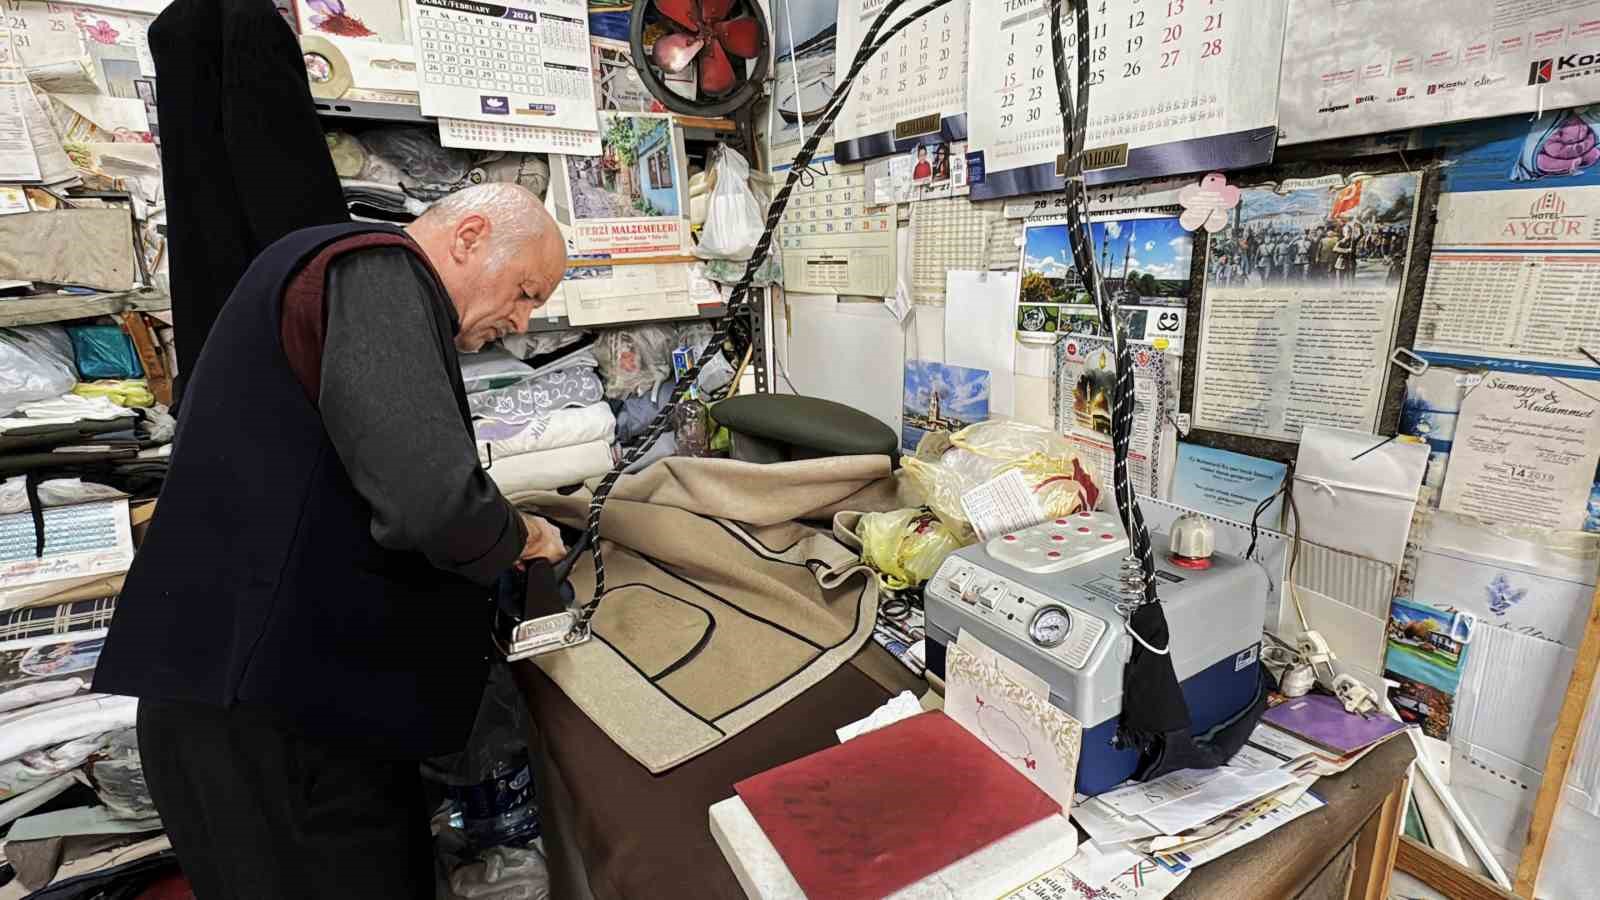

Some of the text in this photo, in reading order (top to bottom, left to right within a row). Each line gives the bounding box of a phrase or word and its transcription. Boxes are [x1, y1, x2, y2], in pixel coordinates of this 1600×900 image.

[511, 11, 534, 20] 2024
[1011, 32, 1015, 45] 1
[1036, 23, 1044, 37] 2
[1098, 0, 1106, 14] 4
[11, 17, 66, 31] 24 25
[1007, 0, 1185, 66] 8 9 10 11 12 13
[15, 34, 31, 47] 31
[1004, 72, 1016, 87] 15
[1032, 66, 1044, 80] 16
[1092, 46, 1107, 62] 18
[1127, 35, 1143, 53] 19
[1161, 24, 1182, 43] 20
[1203, 12, 1223, 32] 21
[1000, 38, 1222, 108] 22 23 25 26 27 28
[1000, 113, 1014, 129] 29
[1025, 106, 1041, 123] 30
[1098, 194, 1113, 204] 31
[1531, 212, 1560, 220] HOTEL
[1543, 390, 1561, 404] &
[1511, 467, 1525, 477] 14
